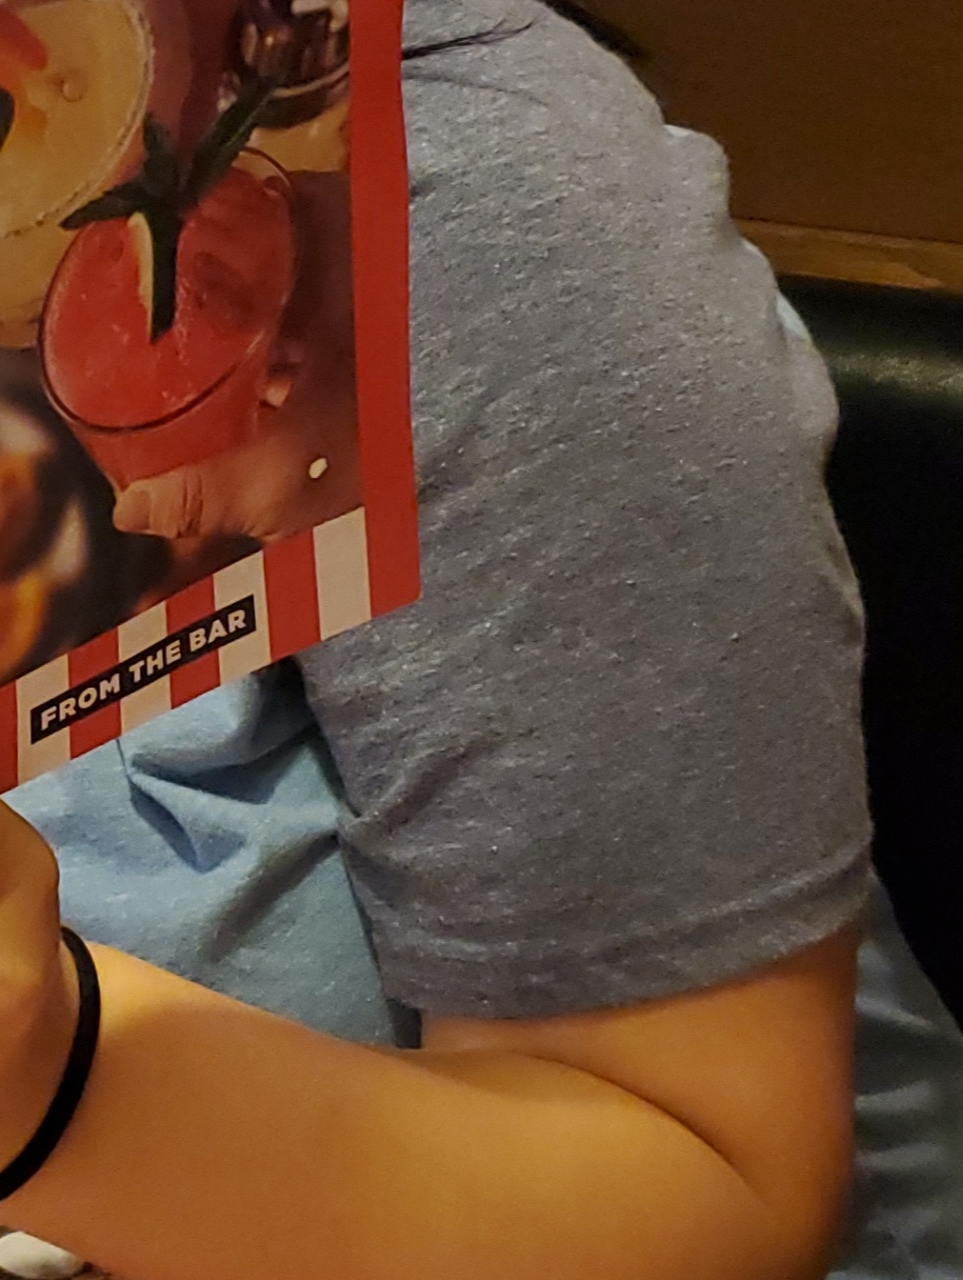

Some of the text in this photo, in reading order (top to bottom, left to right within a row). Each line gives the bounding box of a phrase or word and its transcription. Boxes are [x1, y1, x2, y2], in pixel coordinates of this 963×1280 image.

[41, 609, 247, 731] FROM THE BAR
